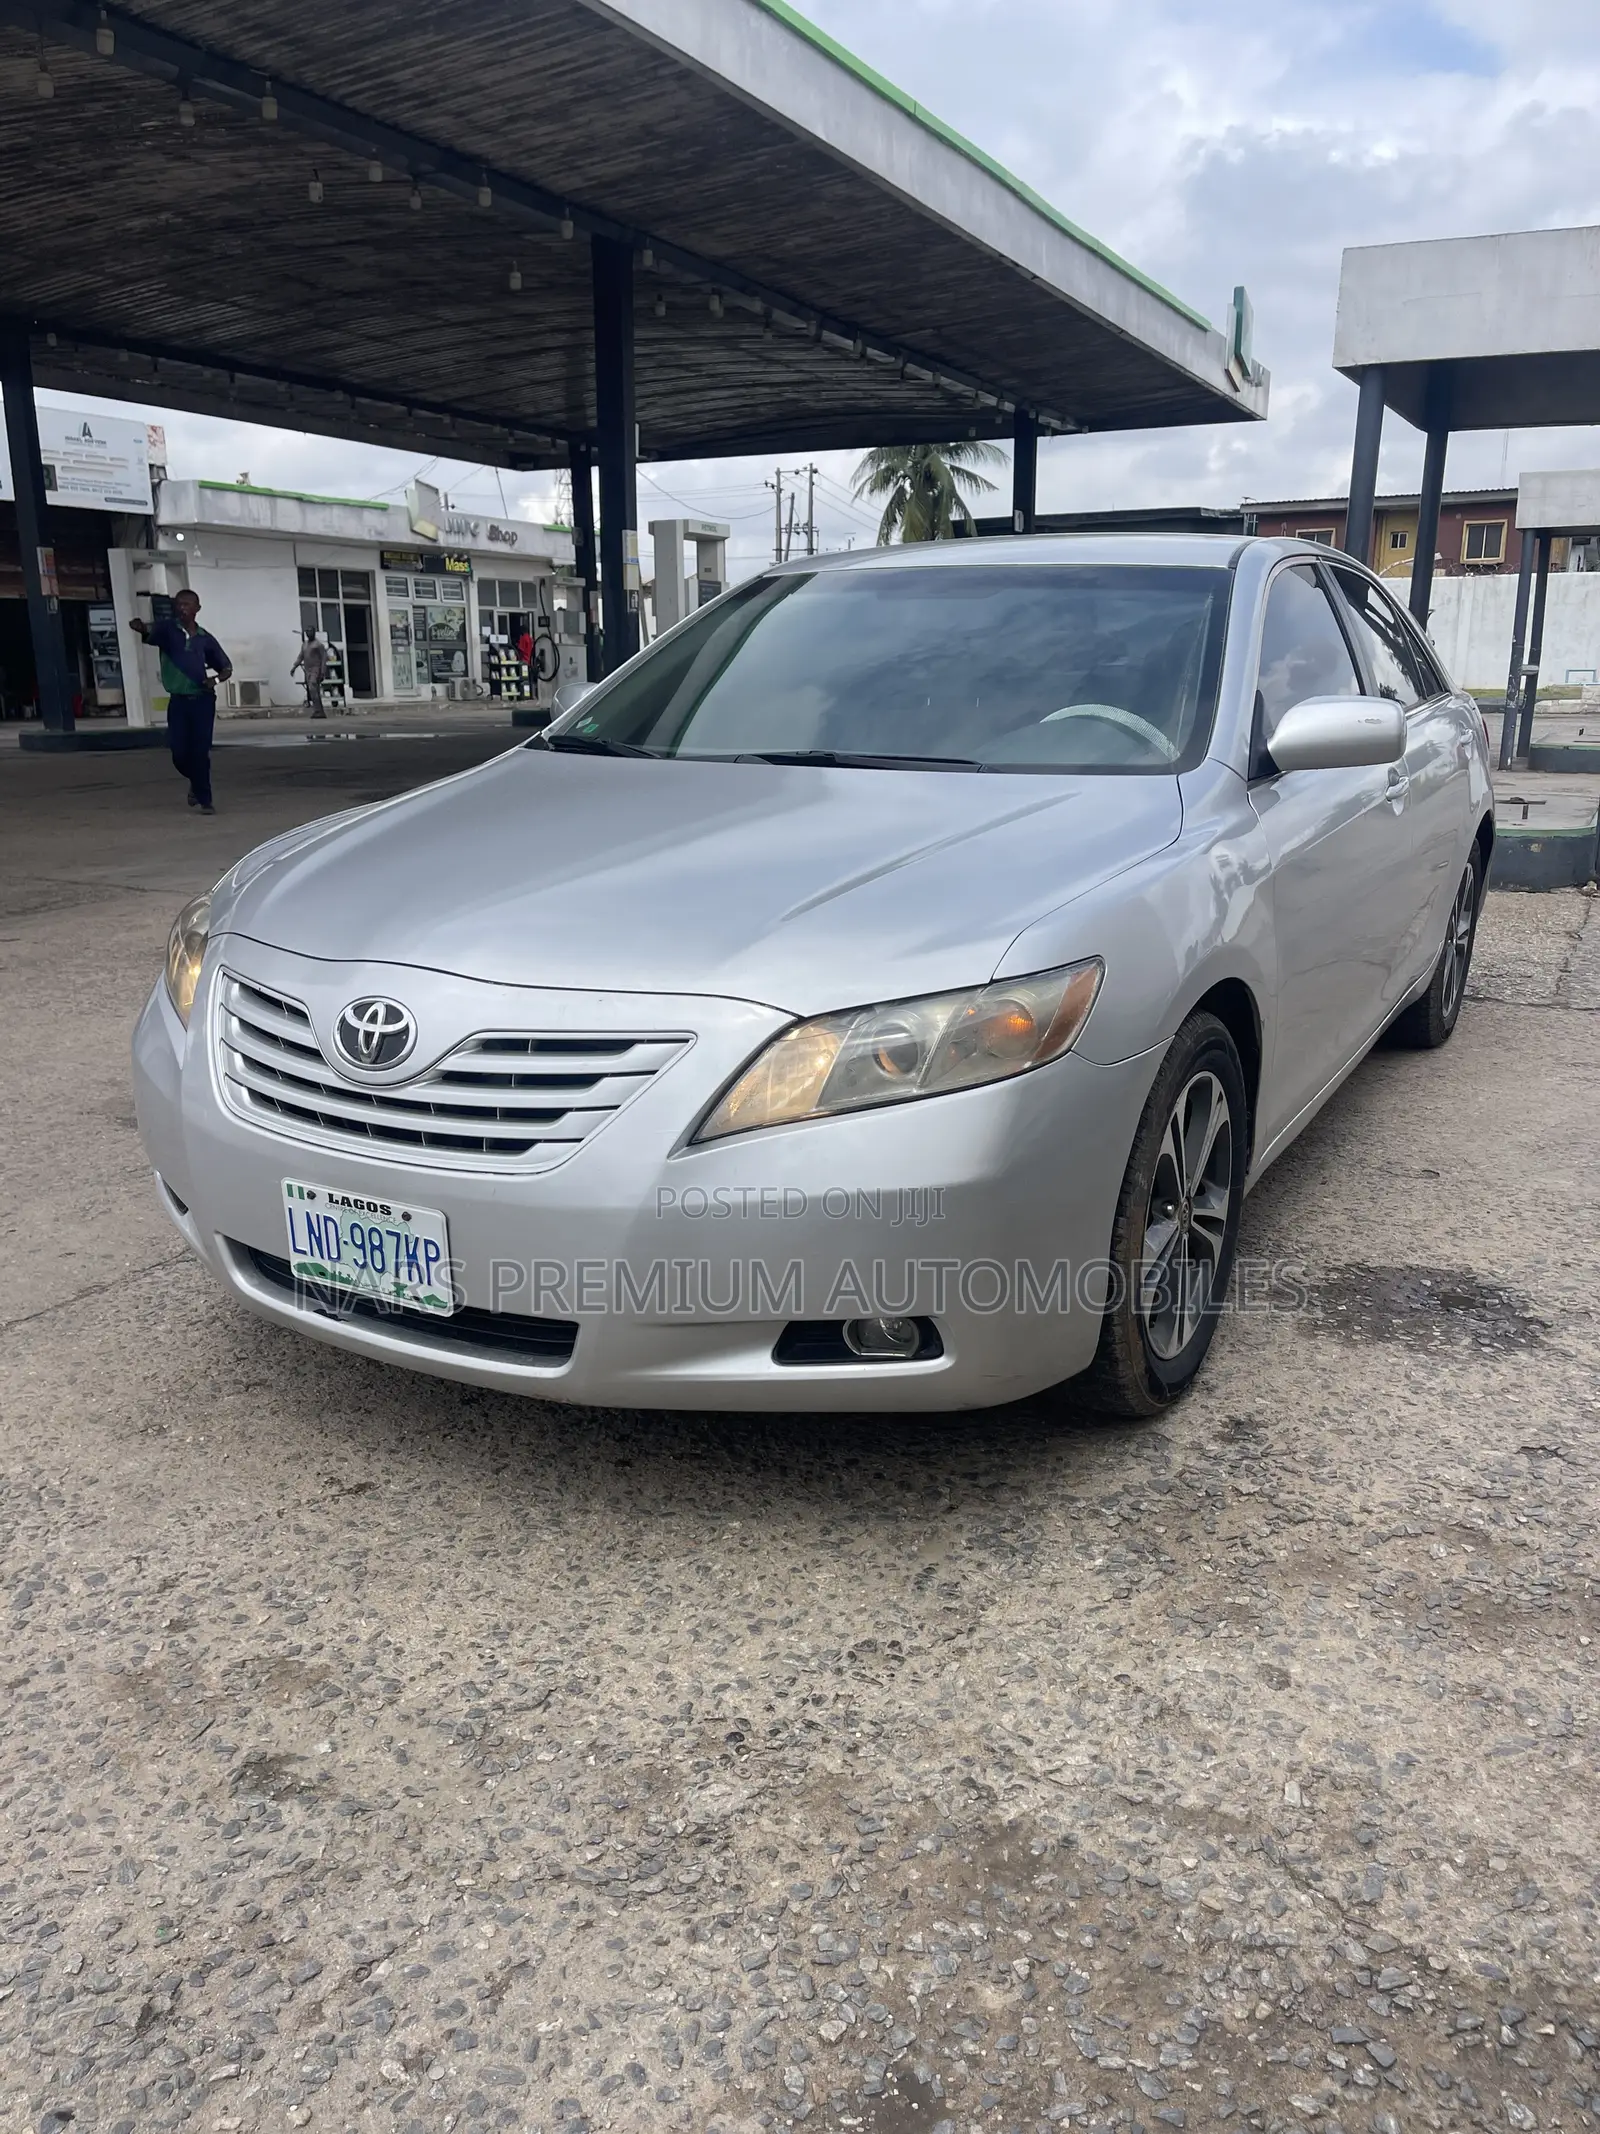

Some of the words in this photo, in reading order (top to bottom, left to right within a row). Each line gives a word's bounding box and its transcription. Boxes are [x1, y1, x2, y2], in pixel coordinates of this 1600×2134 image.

[488, 524, 518, 546] Shop
[446, 557, 470, 572] Mass
[328, 1193, 392, 1216] LAGOS
[288, 1206, 441, 1287] LND-987KP
